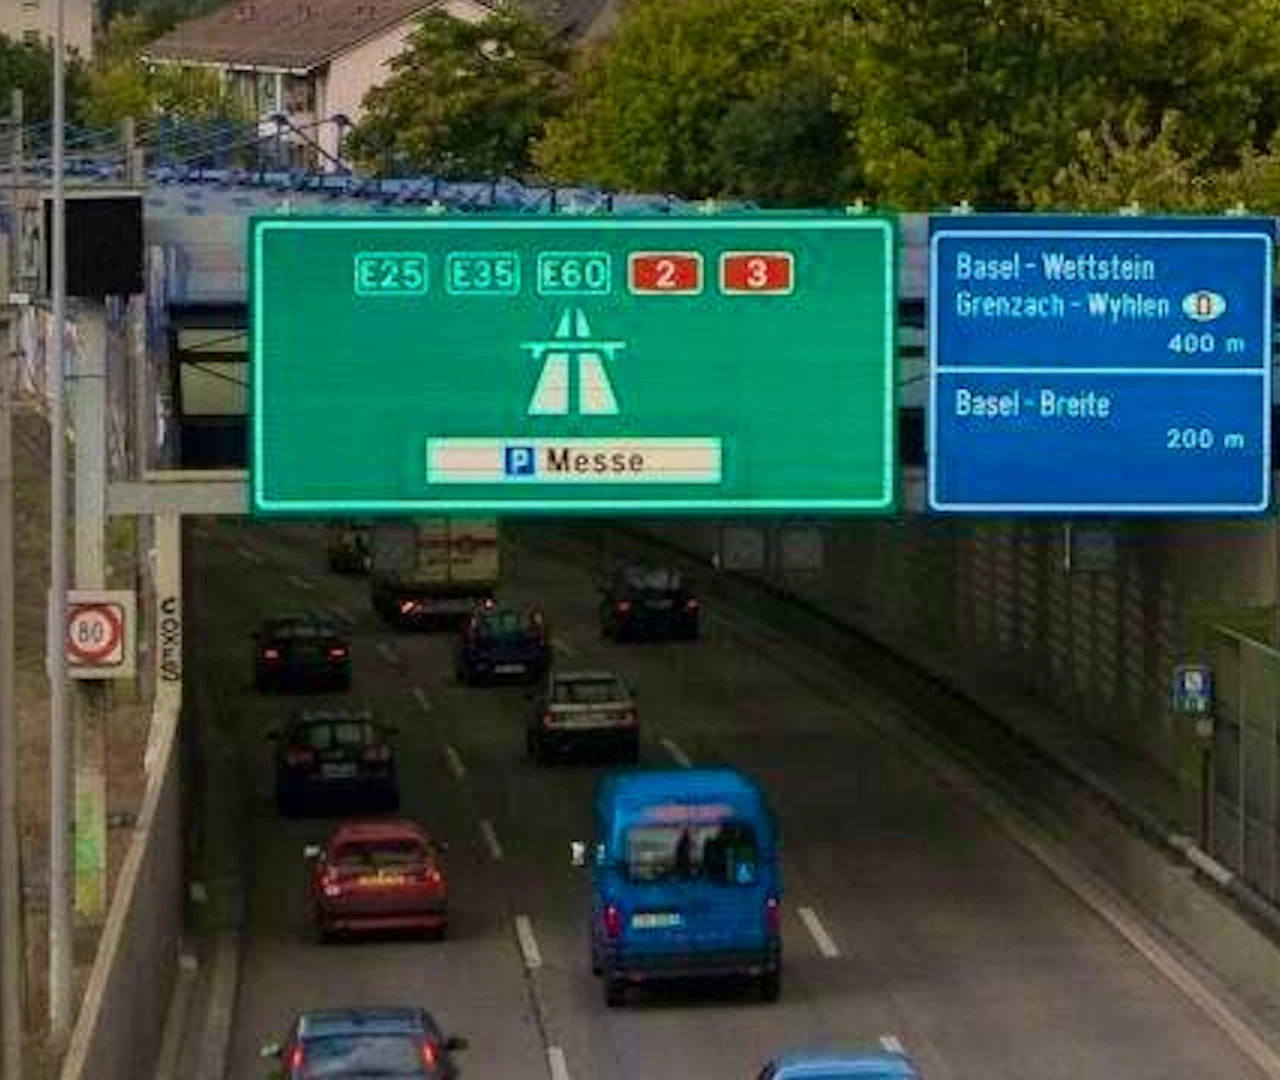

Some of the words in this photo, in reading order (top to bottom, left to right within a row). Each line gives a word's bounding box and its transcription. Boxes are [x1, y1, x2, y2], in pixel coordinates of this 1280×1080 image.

[359, 259, 422, 288] E25
[452, 259, 513, 288] E35
[542, 259, 606, 288] E60
[655, 259, 676, 288] 2
[746, 259, 768, 288] 3
[1166, 333, 1216, 354] 400
[1225, 338, 1245, 354] m
[1166, 427, 1215, 449] 200
[1224, 432, 1245, 449] m
[546, 447, 644, 473] Messe
[78, 620, 104, 644] 80
